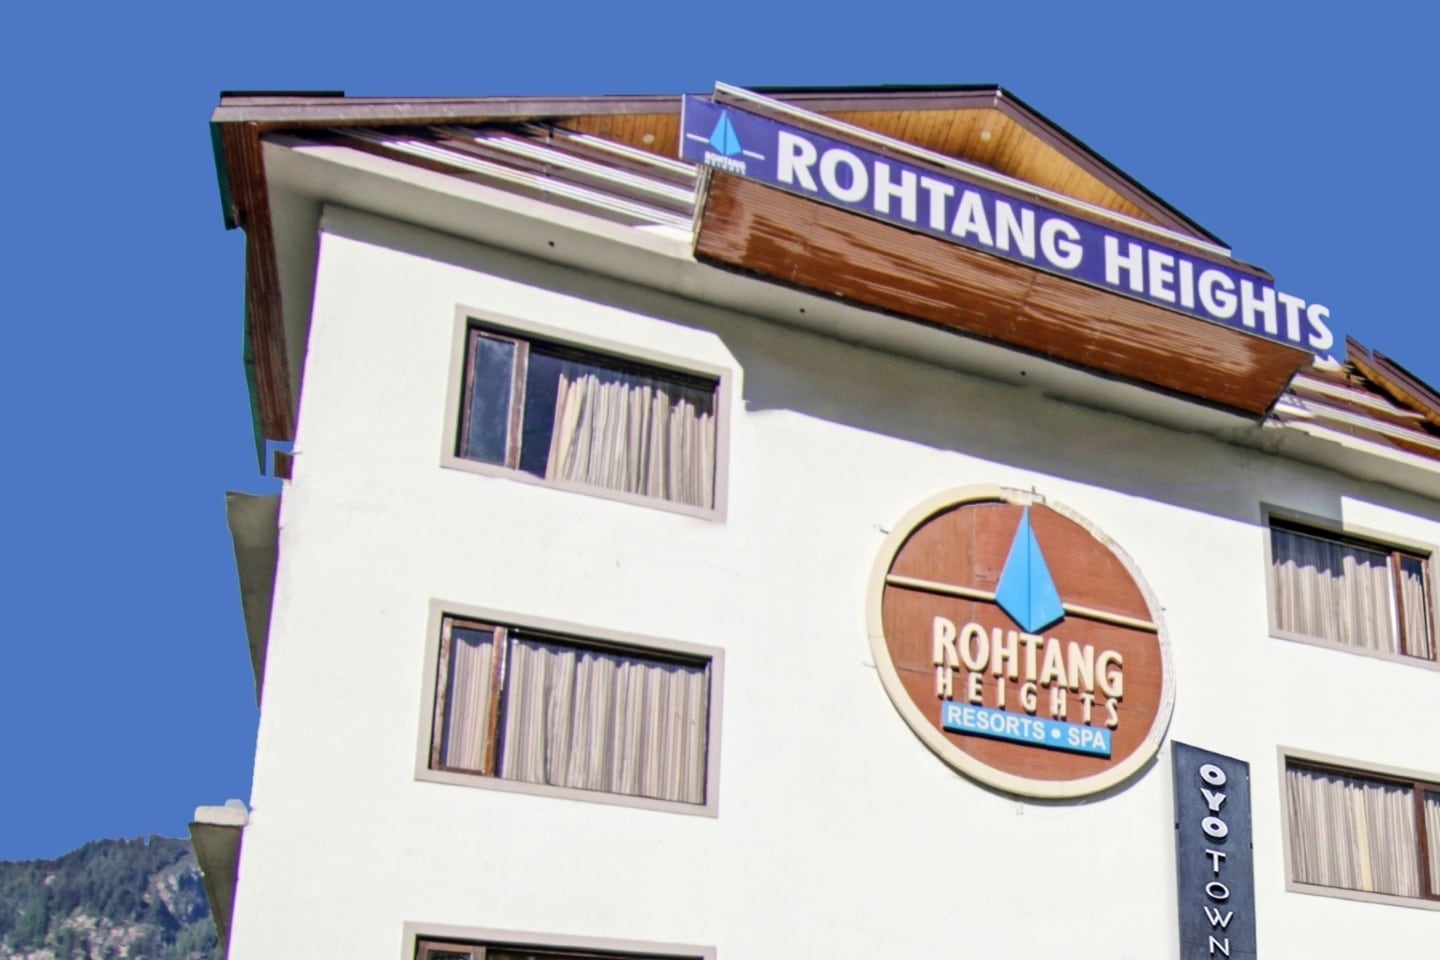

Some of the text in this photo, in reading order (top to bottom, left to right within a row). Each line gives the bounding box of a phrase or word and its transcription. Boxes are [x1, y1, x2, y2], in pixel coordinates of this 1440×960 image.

[777, 130, 1334, 351] ROHTANG HEIGHTS
[933, 616, 1123, 699] ROHTANG
[936, 665, 1119, 728] HEIGHTS
[947, 704, 1107, 750] RESORTS SPA
[1199, 763, 1229, 839] OYO
